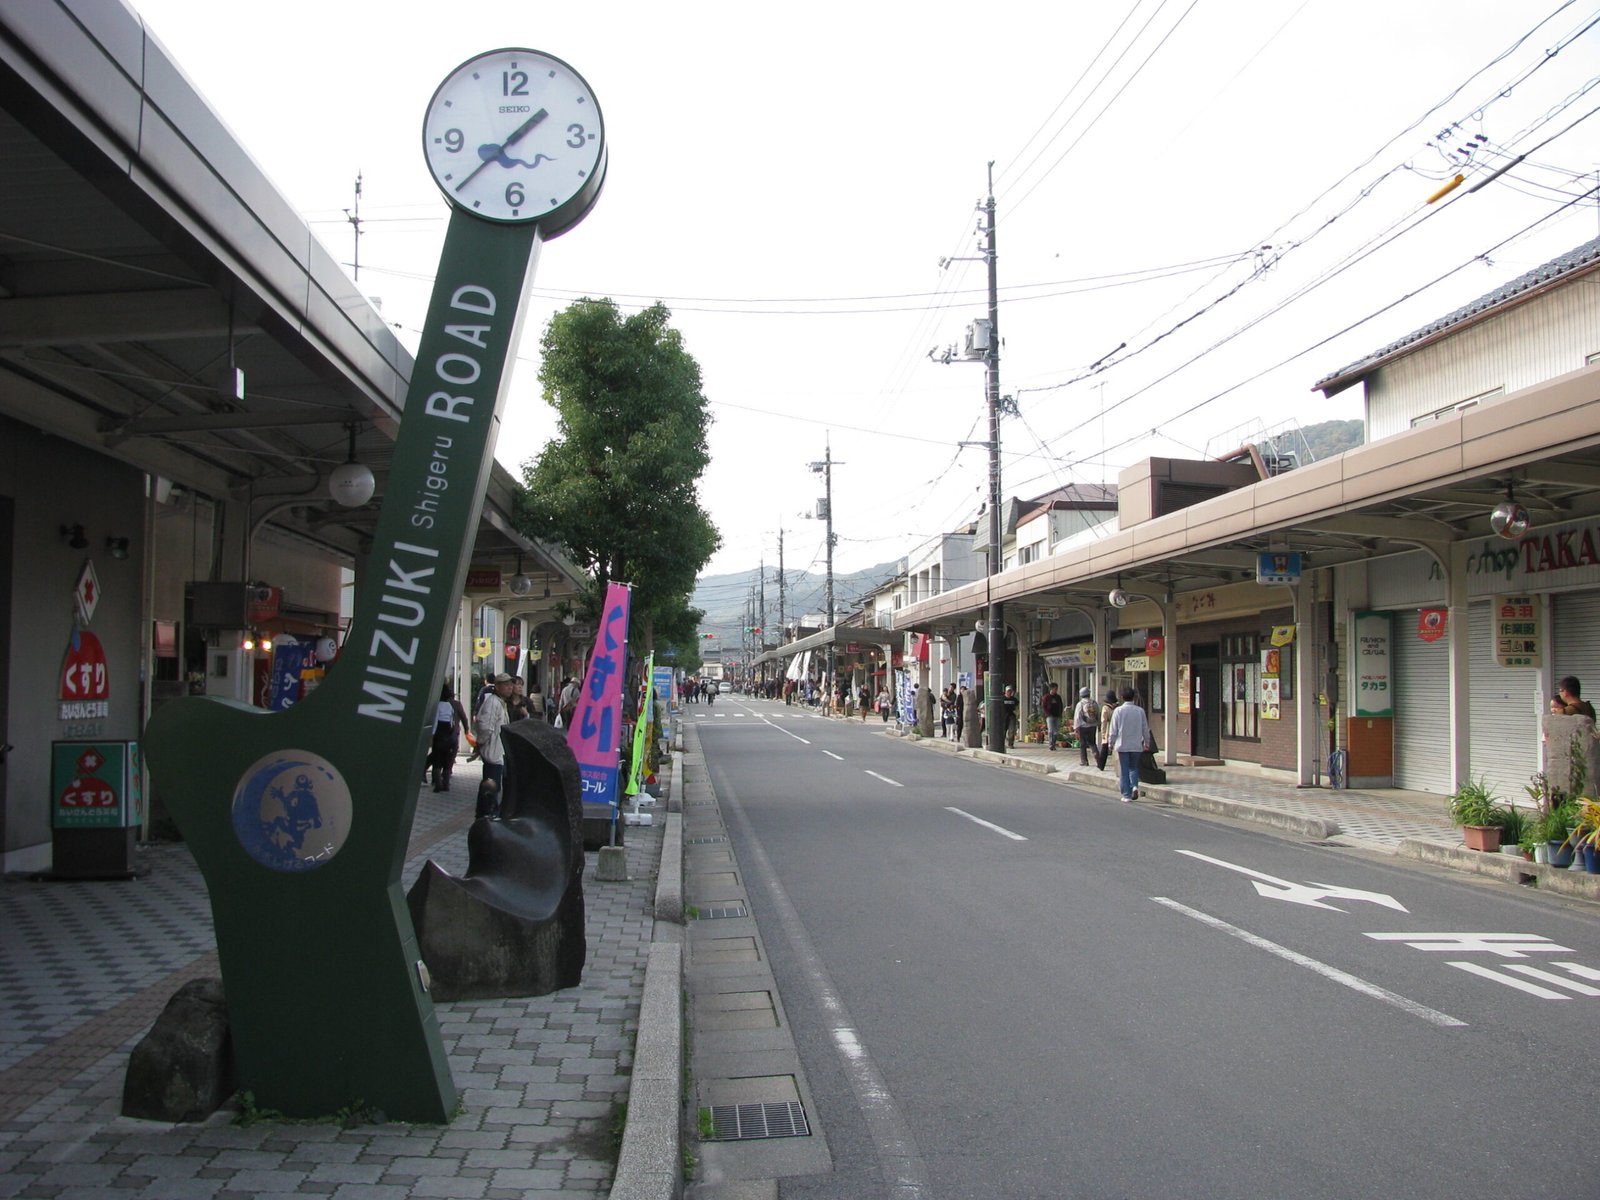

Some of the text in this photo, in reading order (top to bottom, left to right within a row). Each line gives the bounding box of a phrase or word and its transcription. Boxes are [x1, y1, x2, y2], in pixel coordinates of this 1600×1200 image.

[503, 71, 529, 96] 12
[499, 105, 531, 114] SEIKO
[444, 128, 464, 153] 9
[566, 123, 585, 149] 3
[505, 182, 525, 207] 6
[357, 283, 498, 723] MIZUKI Shigeru ROAD
[1519, 527, 1600, 573] TAKA
[65, 662, 106, 694] くすり
[580, 605, 624, 753] くすり
[1361, 681, 1387, 690] タカラ
[64, 791, 114, 806] くすり
